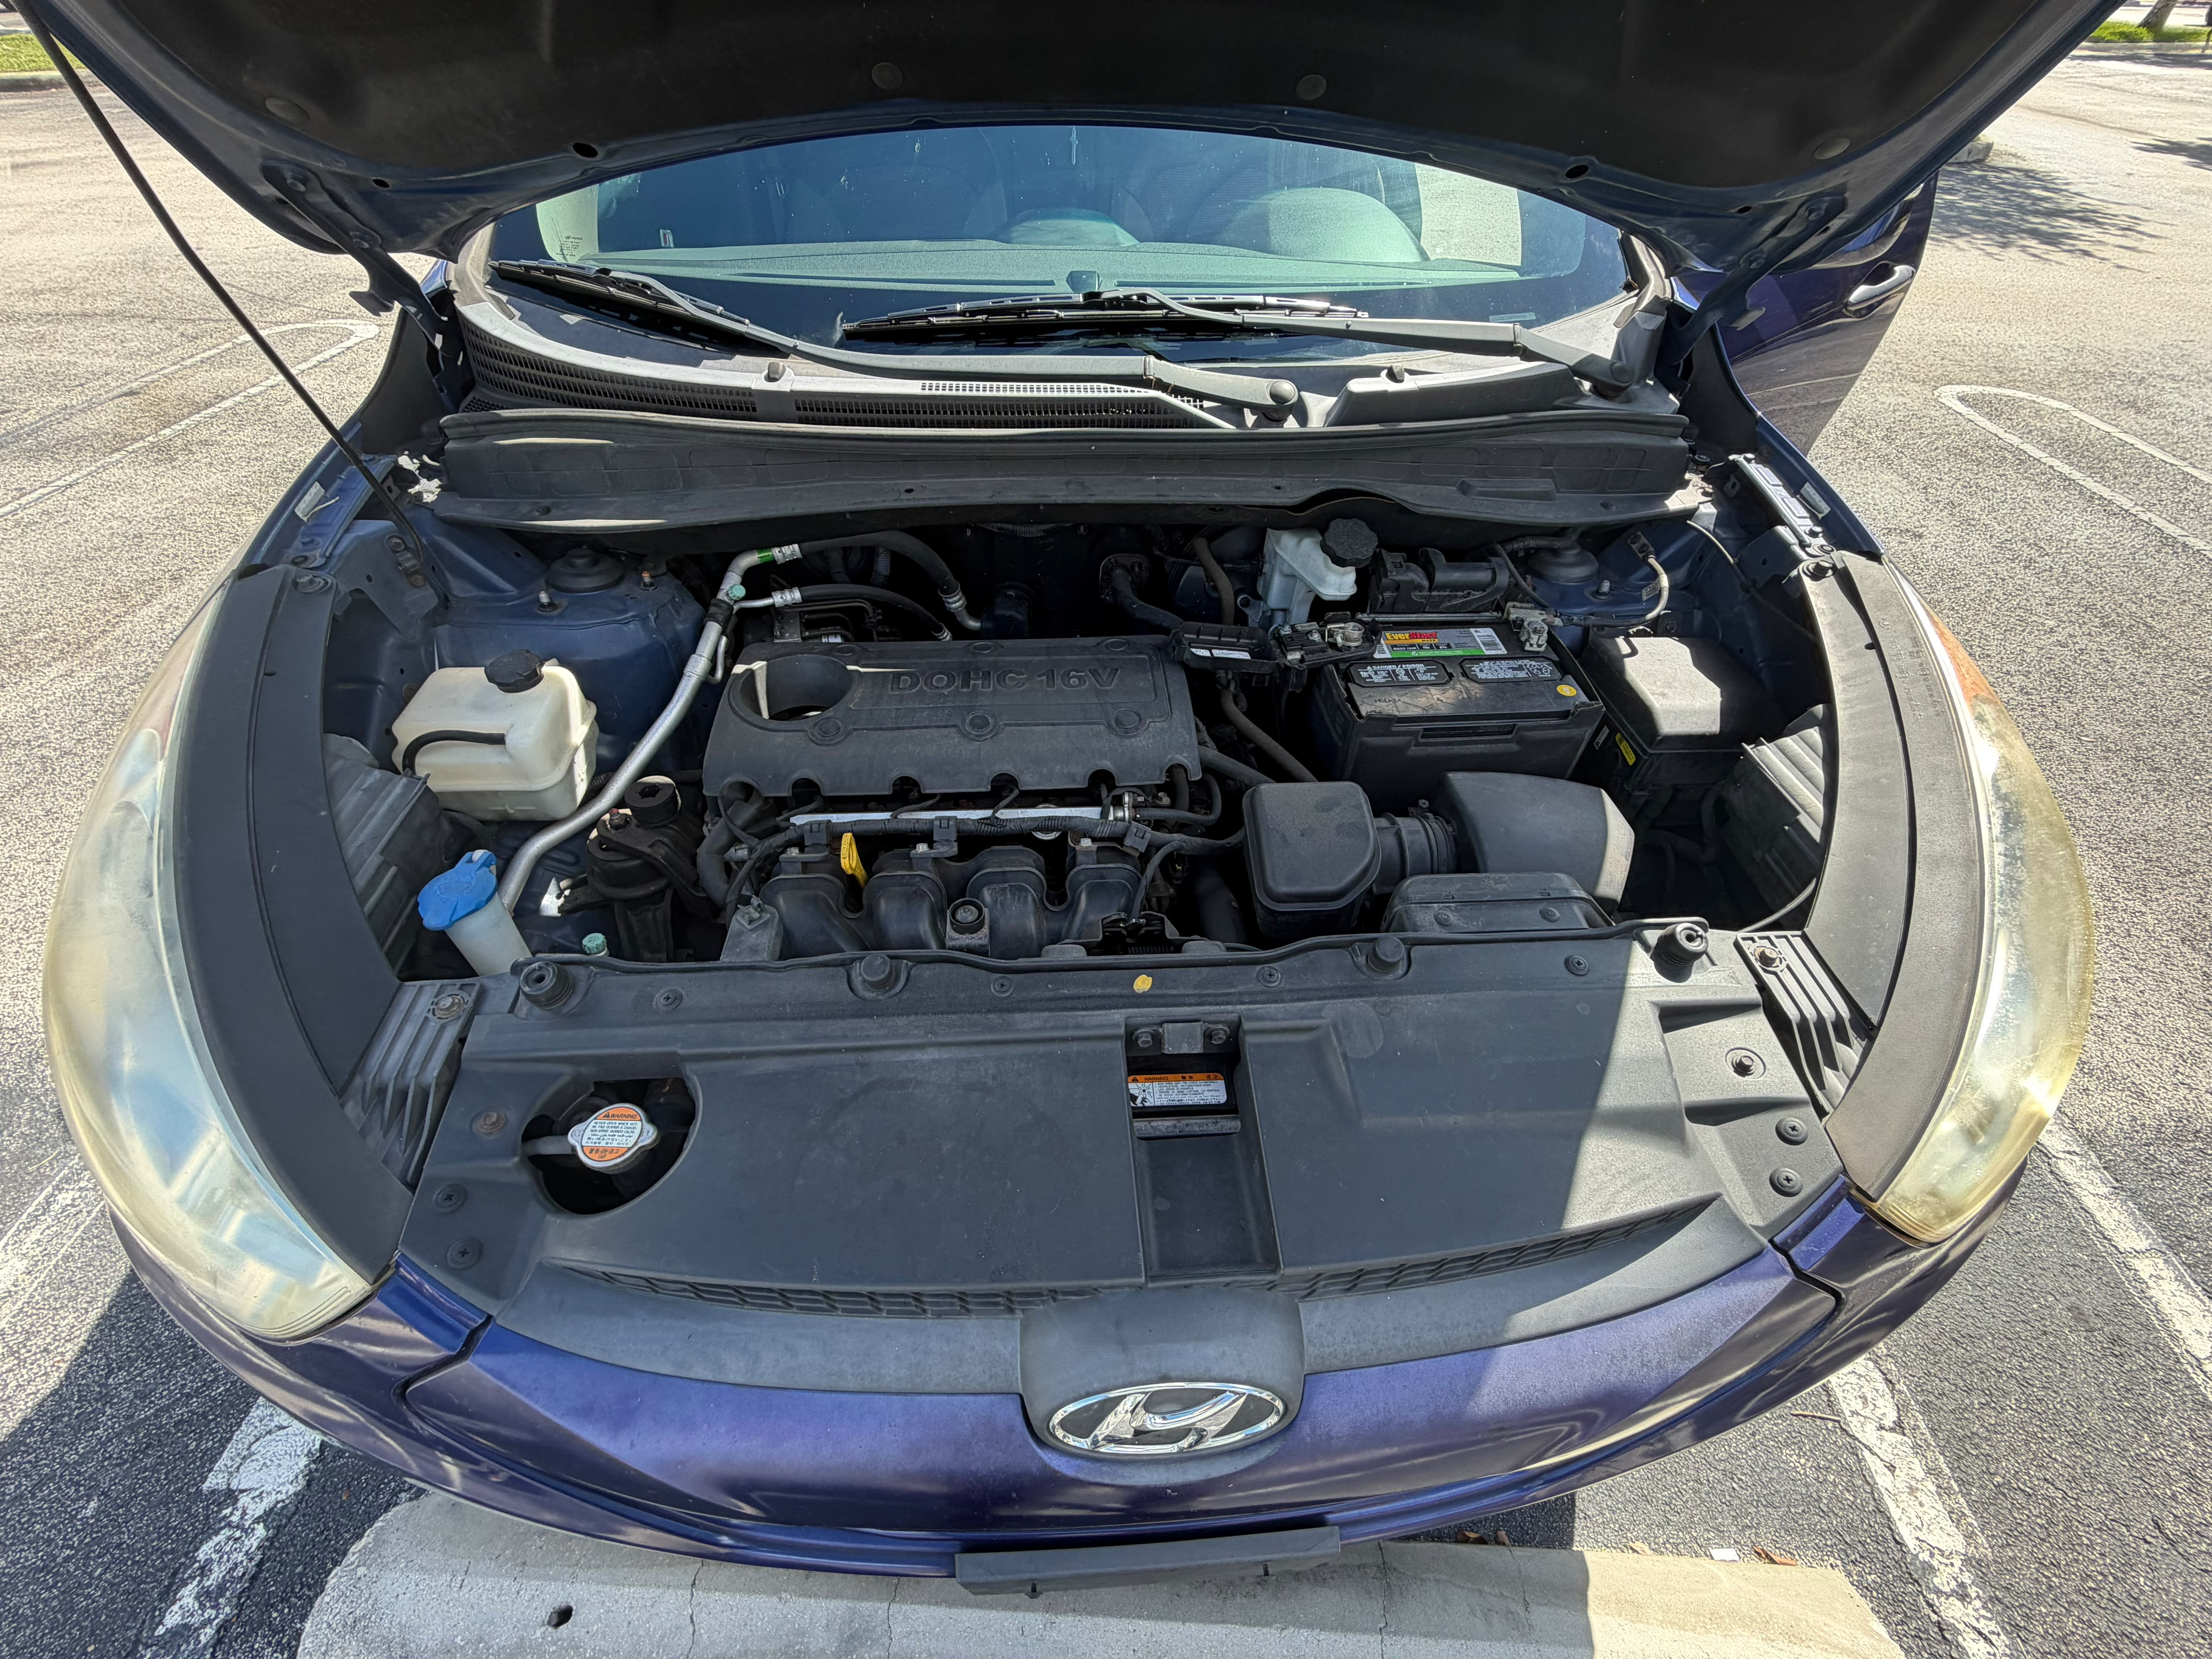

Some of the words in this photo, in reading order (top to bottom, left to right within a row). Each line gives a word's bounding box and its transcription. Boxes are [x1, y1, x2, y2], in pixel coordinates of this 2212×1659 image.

[1385, 632, 1437, 640] EverStart
[889, 669, 1027, 694] DOHC
[1037, 668, 1120, 690] 16V
